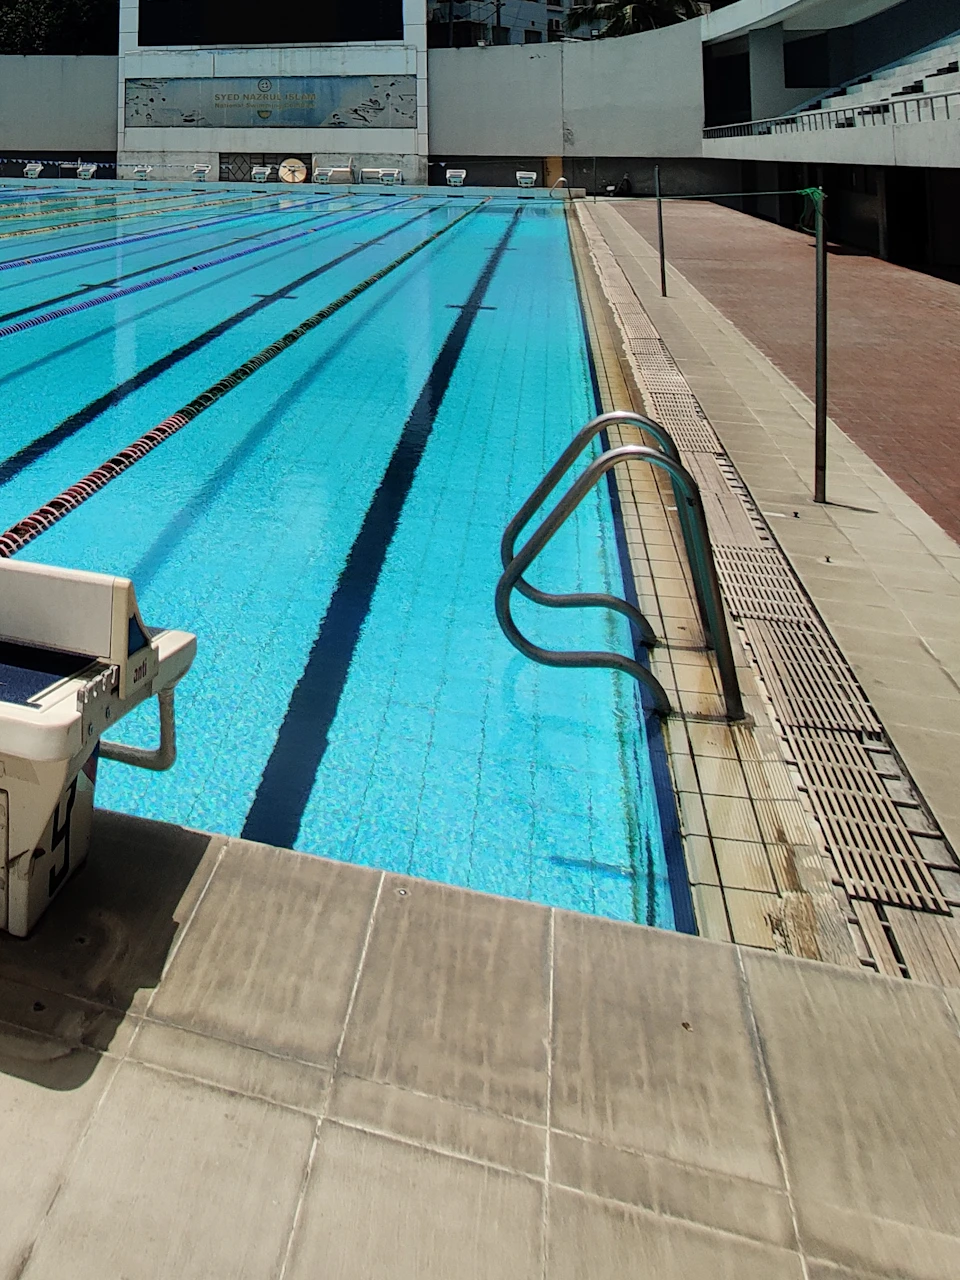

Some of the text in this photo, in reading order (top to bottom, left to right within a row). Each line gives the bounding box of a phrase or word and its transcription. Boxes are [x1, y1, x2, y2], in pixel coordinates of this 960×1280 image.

[214, 93, 317, 101] SYED NAZRUL ISLAM
